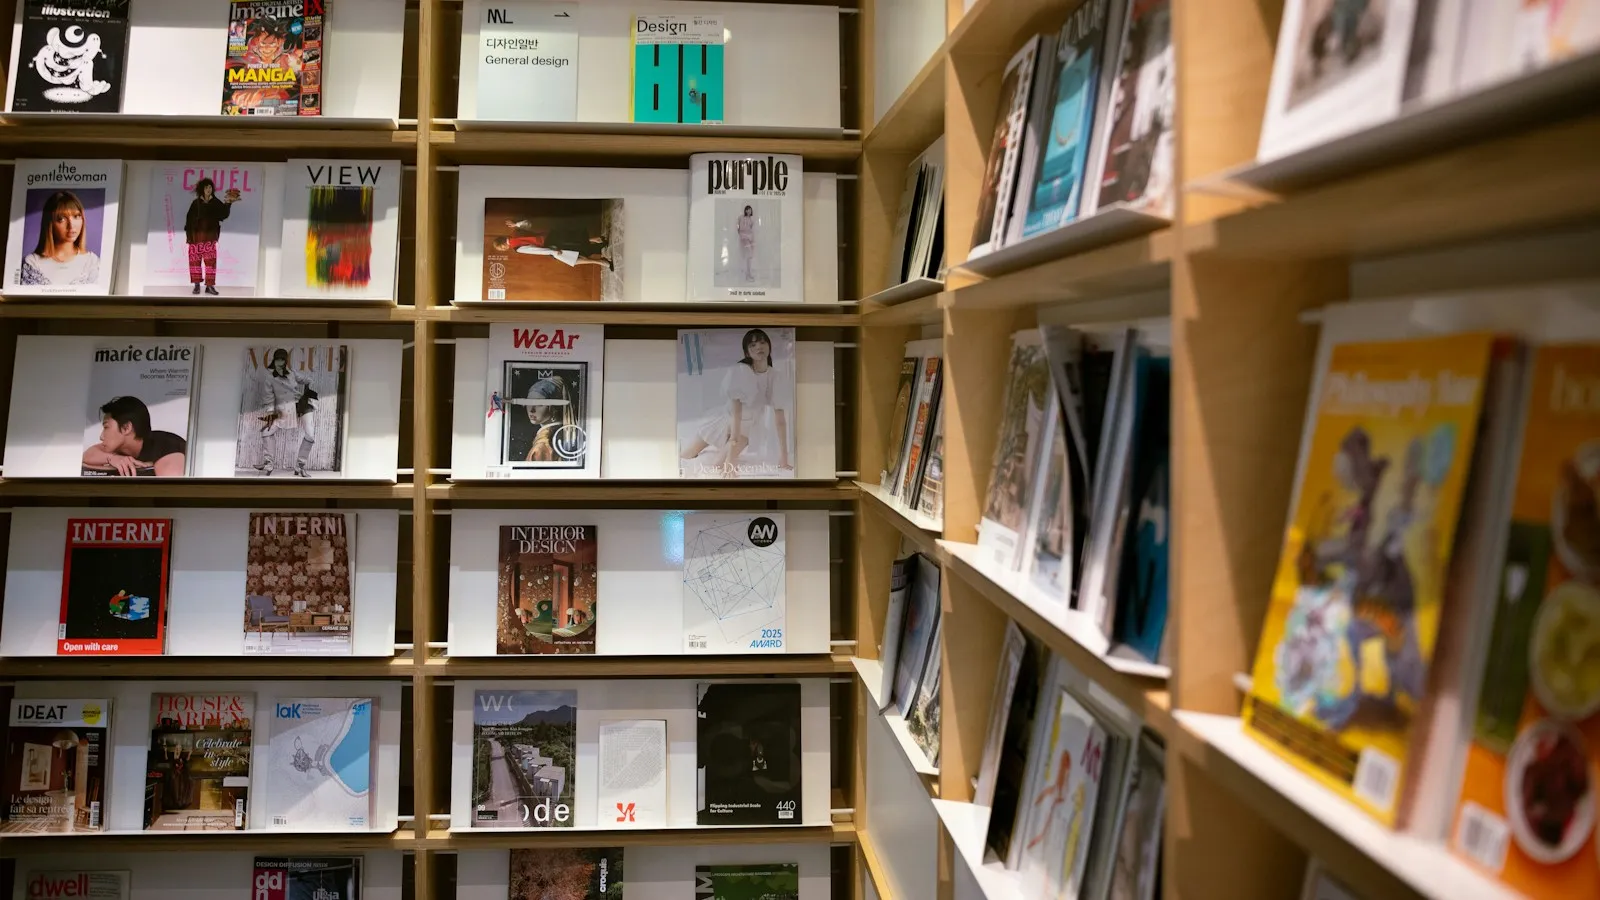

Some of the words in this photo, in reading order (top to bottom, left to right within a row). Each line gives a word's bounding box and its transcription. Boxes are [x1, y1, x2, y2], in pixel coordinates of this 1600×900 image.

[41, 4, 110, 18] illustration
[637, 19, 687, 35] Design
[486, 38, 539, 50] 디자인일반
[485, 55, 529, 65] General
[531, 56, 569, 68] design
[228, 68, 297, 82] MANGA
[58, 161, 77, 173] the
[27, 169, 107, 185] gentlewoman
[306, 165, 381, 185] VIEW
[708, 156, 788, 195] purple
[512, 328, 580, 350] WeAr
[94, 344, 143, 362] marie
[145, 344, 191, 361] claire
[72, 522, 165, 542] INTERNI
[255, 516, 343, 535] INTERNI
[750, 524, 776, 540] AW
[510, 526, 585, 540] INTERIOR
[520, 540, 577, 554] DESIGN
[761, 629, 782, 638] 2025
[63, 642, 83, 652] Open
[84, 642, 100, 651] with
[749, 639, 782, 648] AWARD
[17, 704, 68, 720] IDEAT
[195, 738, 242, 749] Celebrate
[203, 749, 215, 758] in
[210, 757, 234, 770] style
[11, 794, 22, 804] Le
[23, 794, 53, 806] design
[776, 800, 796, 811] 440
[10, 805, 24, 814] fait
[255, 871, 283, 890] dd
[599, 857, 609, 893] croquis
[29, 873, 88, 897] dwell
